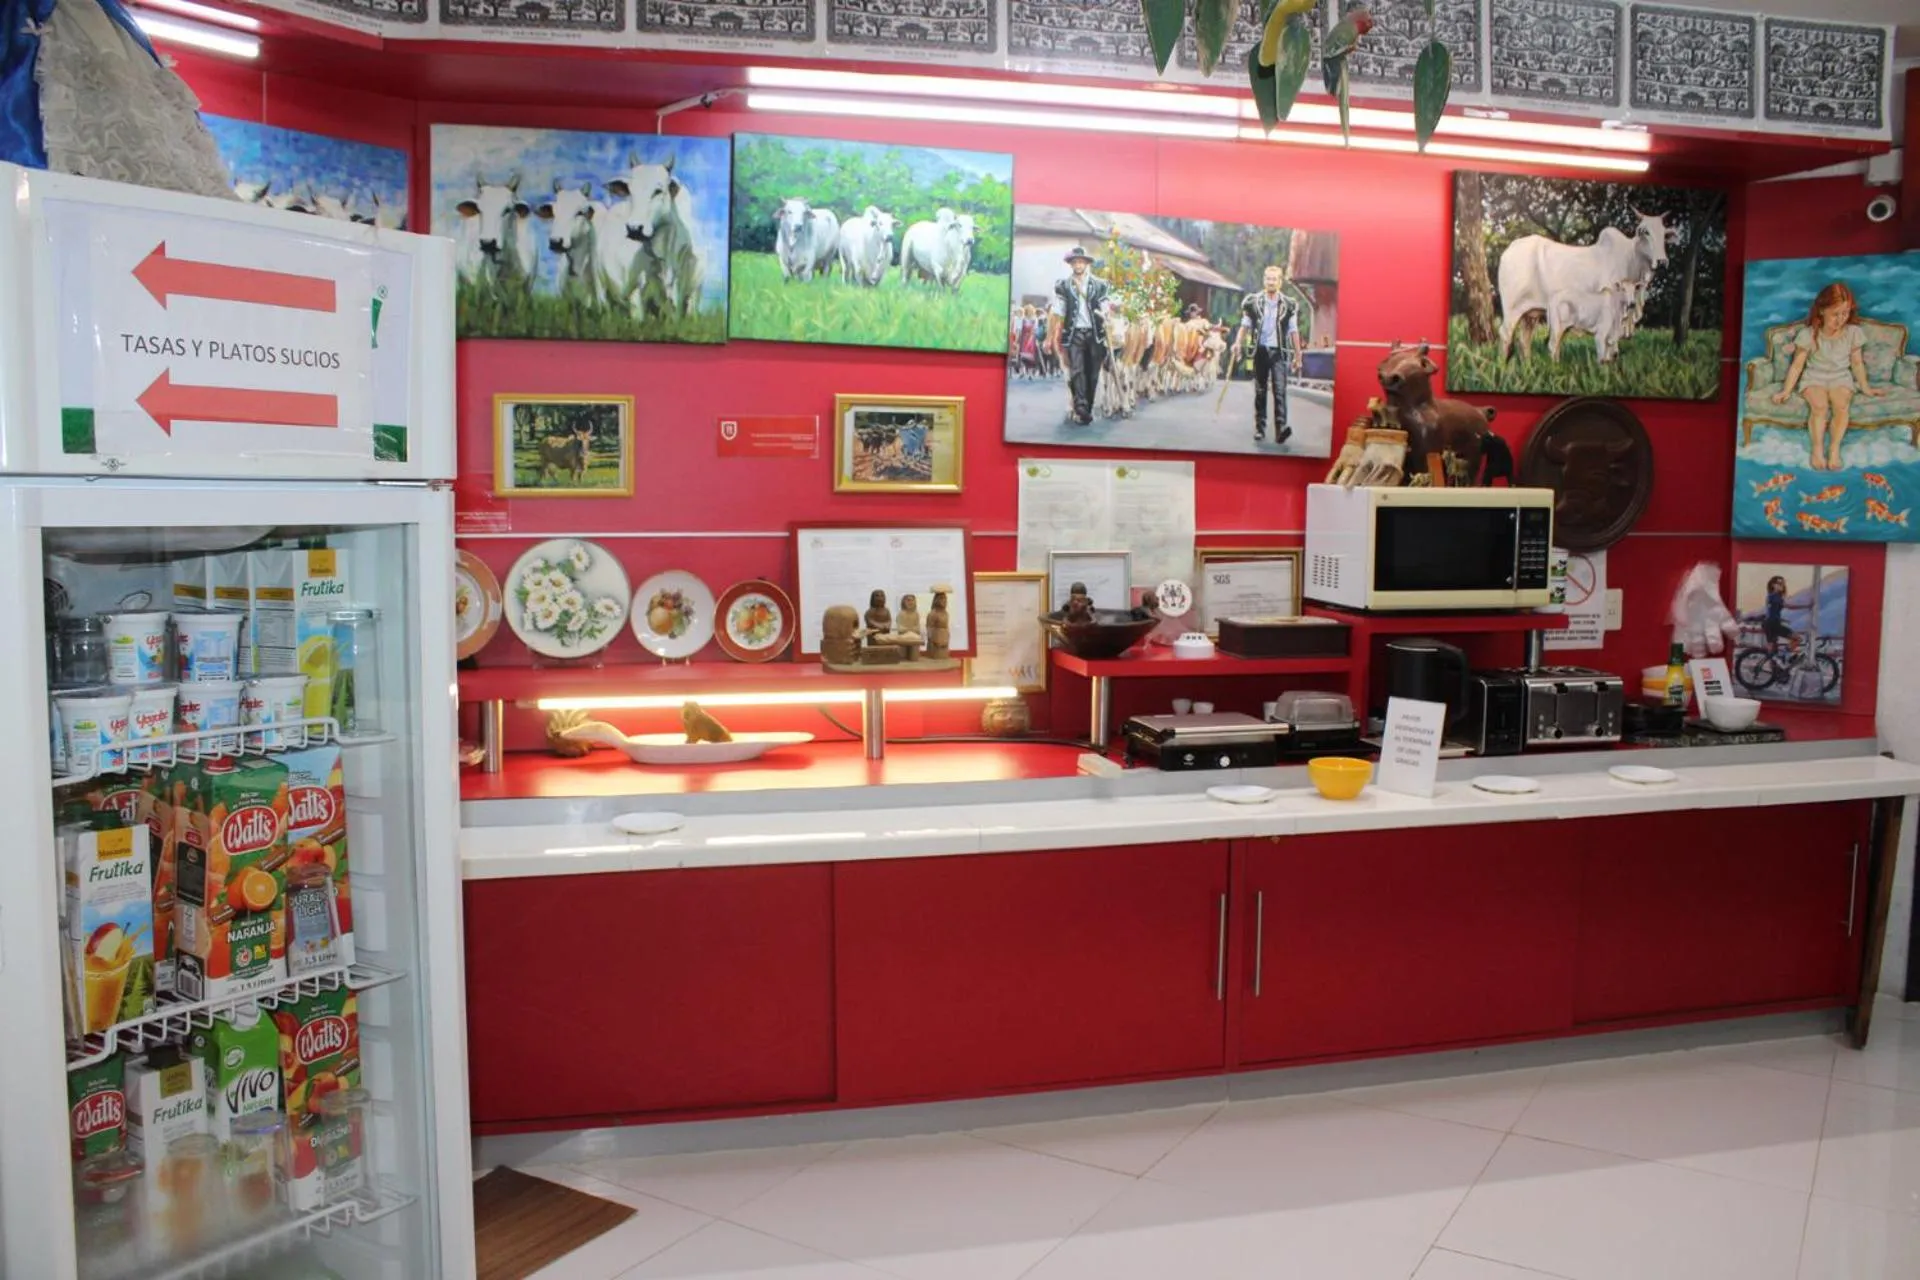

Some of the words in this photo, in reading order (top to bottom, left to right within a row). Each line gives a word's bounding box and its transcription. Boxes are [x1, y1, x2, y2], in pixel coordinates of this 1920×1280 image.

[120, 333, 186, 357] TASAS
[191, 339, 203, 358] Y
[209, 341, 277, 364] PLATOS
[280, 347, 341, 370] SUCIOS
[301, 578, 345, 598] Frutika
[88, 860, 144, 883] Frutika
[226, 920, 277, 943] NARANJA
[226, 1067, 275, 1114] VIVO
[152, 1097, 204, 1125] Frutika
